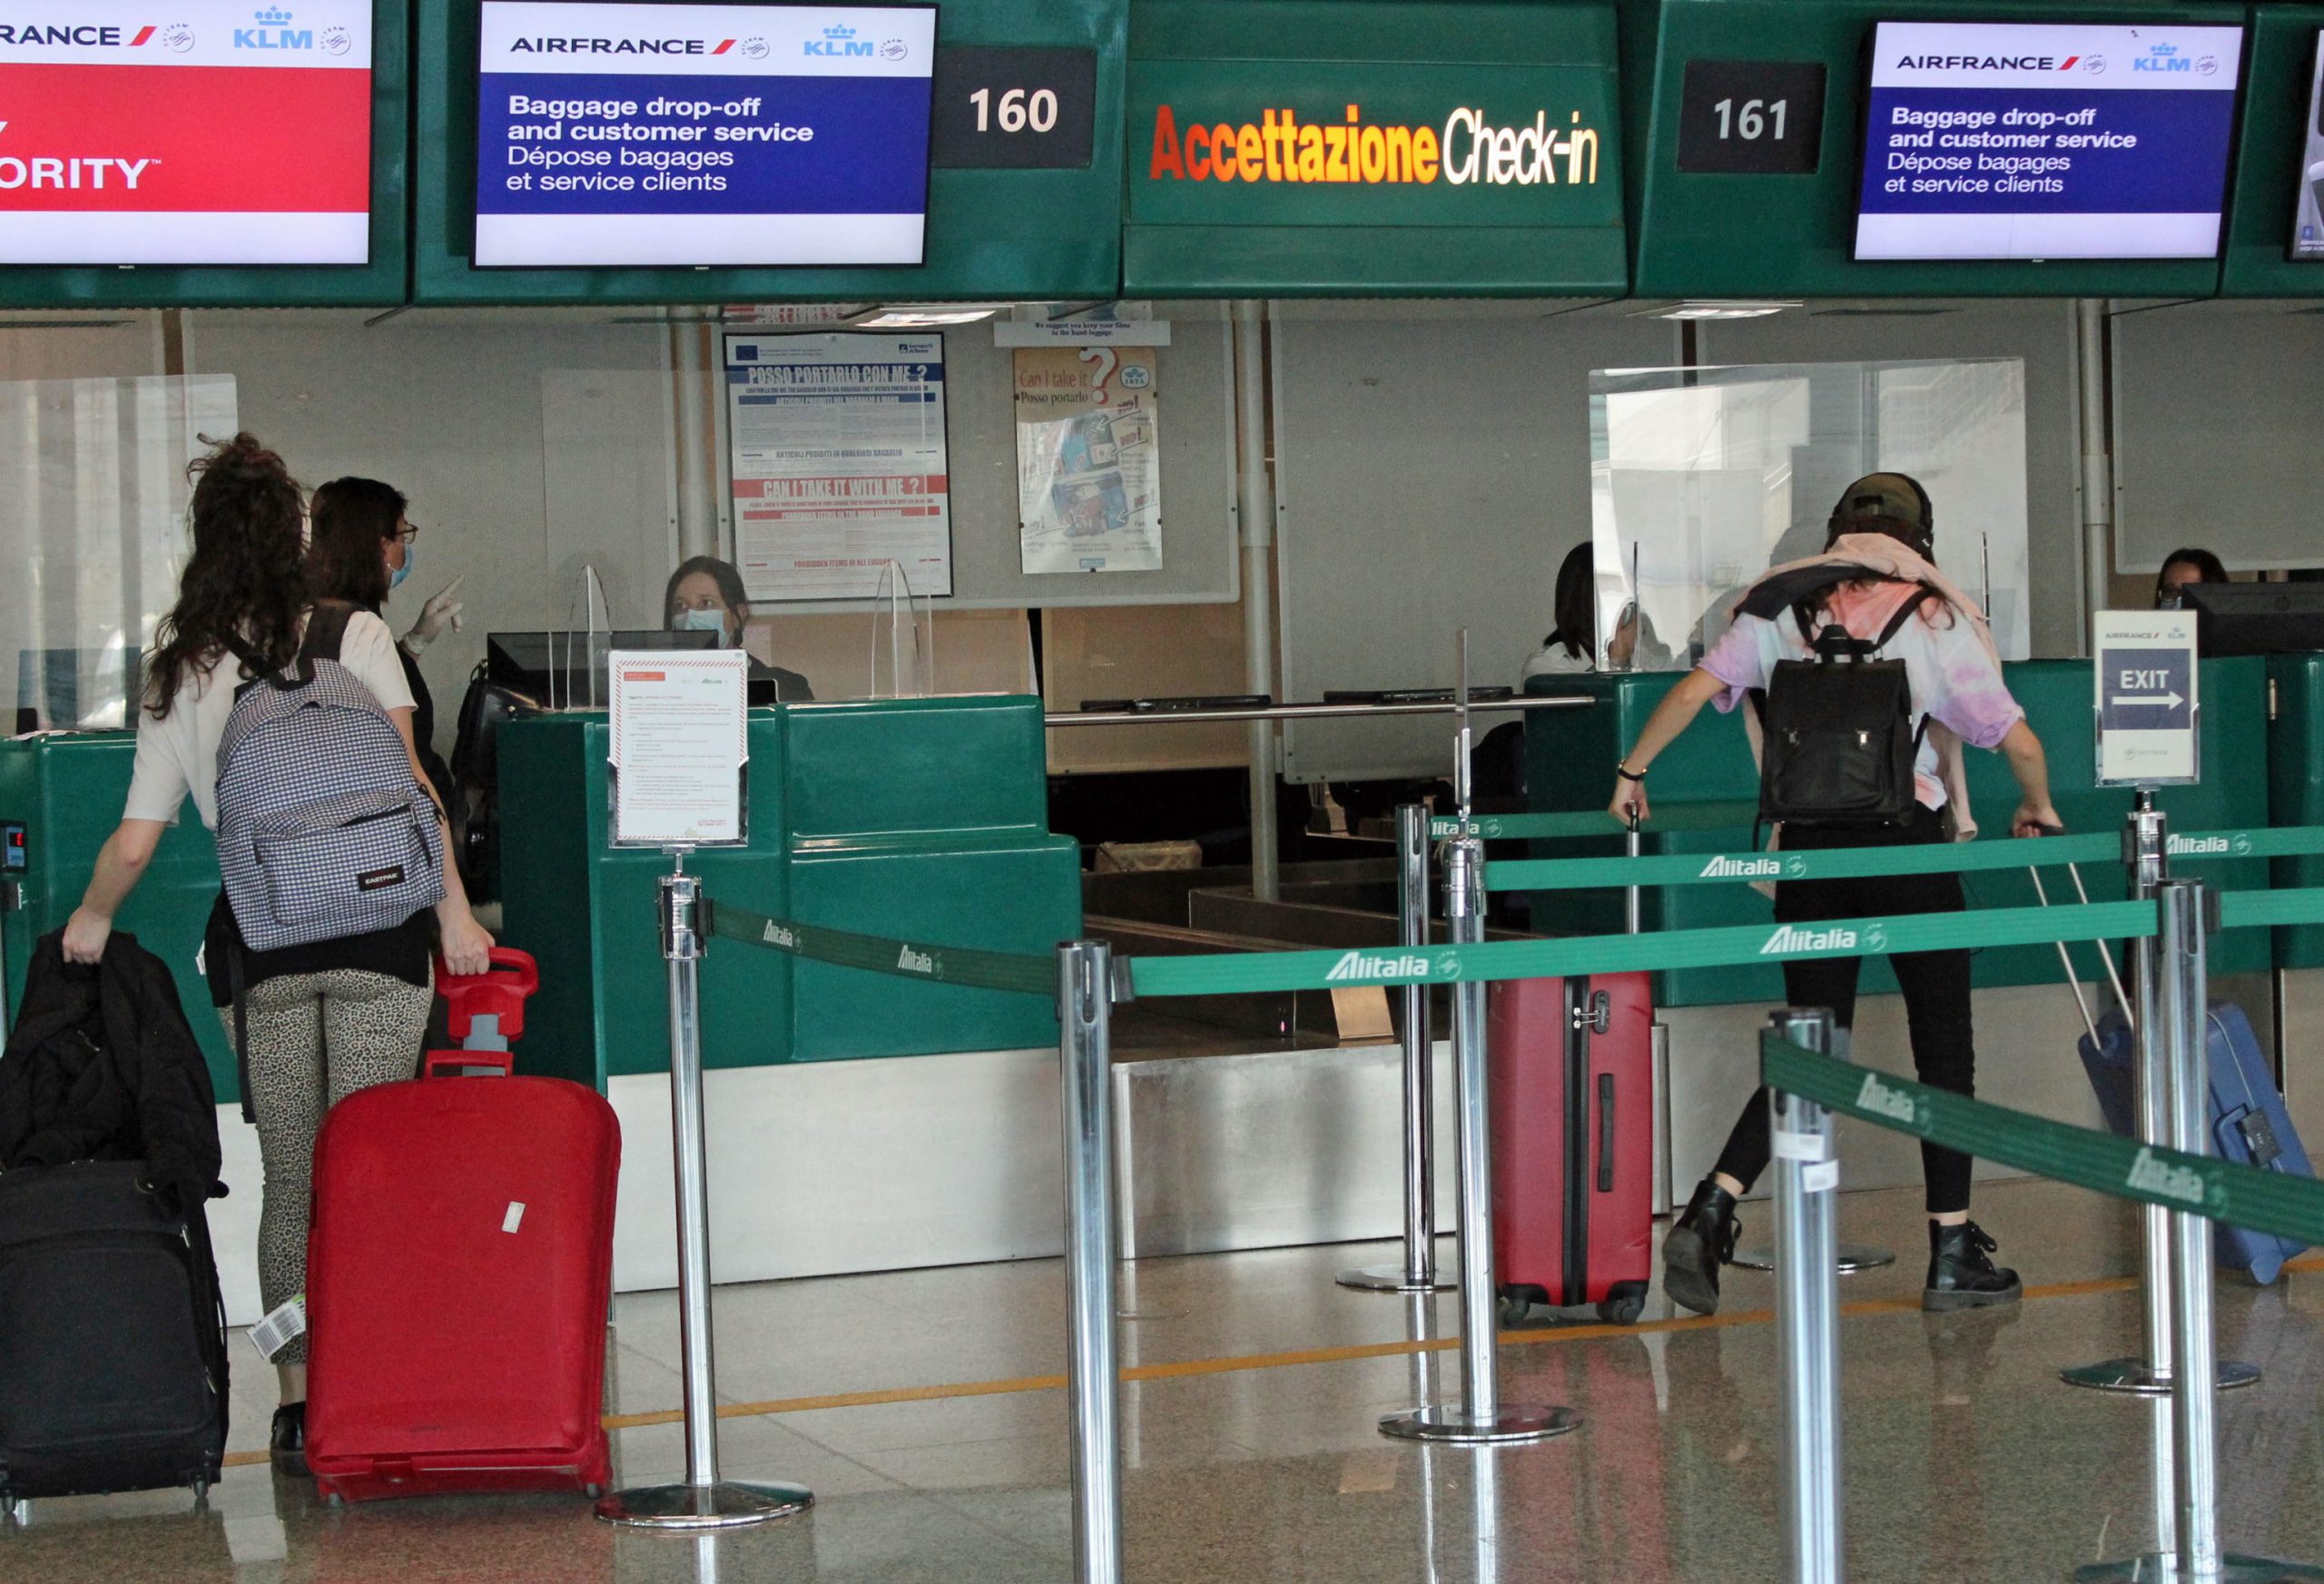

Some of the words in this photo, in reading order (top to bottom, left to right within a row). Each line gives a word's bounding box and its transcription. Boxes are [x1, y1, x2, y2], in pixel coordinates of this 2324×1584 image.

[0, 25, 121, 46] RANCE
[233, 28, 313, 50] KLM
[510, 37, 704, 54] AIRFRANCE
[803, 41, 874, 56] KLM
[1896, 55, 2054, 71] AIRFRANCE
[2133, 57, 2191, 72] KLM
[508, 94, 638, 120] Baggage
[645, 96, 762, 121] drop-off
[969, 87, 1059, 134] 160
[1891, 106, 1997, 129] Baggage
[2002, 107, 2097, 130] drop-off
[1714, 98, 1787, 140] 161
[507, 121, 562, 141] and
[570, 122, 707, 142] customer
[714, 123, 814, 142] service
[1888, 130, 1935, 148] and
[1939, 131, 2051, 149] customer
[2054, 131, 2138, 149] service
[1148, 103, 1440, 184] Accettazione
[1443, 107, 1599, 185] Check-in
[507, 145, 612, 170] Dépose
[620, 146, 734, 171] bagages
[1887, 152, 1973, 174] Dépose
[1977, 152, 2071, 174] bagages
[506, 172, 532, 191] et
[539, 172, 635, 192] service
[642, 172, 727, 192] clients
[1884, 176, 1906, 193] et
[1911, 175, 1990, 193] service
[1994, 175, 2064, 193] clients
[1046, 322, 1068, 330] suggest
[748, 367, 793, 384] POSSO
[794, 366, 860, 384] PORTARLO
[863, 366, 889, 383] CON
[891, 365, 911, 382] ME
[1019, 370, 1042, 388] Can
[1052, 369, 1076, 388] take
[1080, 369, 1088, 387] it
[1021, 391, 1048, 404] Posso
[1050, 391, 1088, 406] portarlo
[763, 480, 791, 498] CAN
[793, 480, 798, 497] I
[800, 479, 832, 497] TAKE
[833, 479, 848, 497] IT
[849, 478, 883, 497] WITH
[886, 478, 905, 496] ME
[909, 477, 920, 495] ?
[2120, 669, 2170, 690] EXIT
[2167, 833, 2230, 855] Alitalia
[1699, 855, 1781, 878] Alitalia
[365, 871, 399, 885] EASTPAK
[763, 919, 793, 947] Alitalia
[1759, 925, 1857, 954] Alitalia
[897, 944, 932, 974] Alitalia
[1324, 951, 1430, 981] Alitalia
